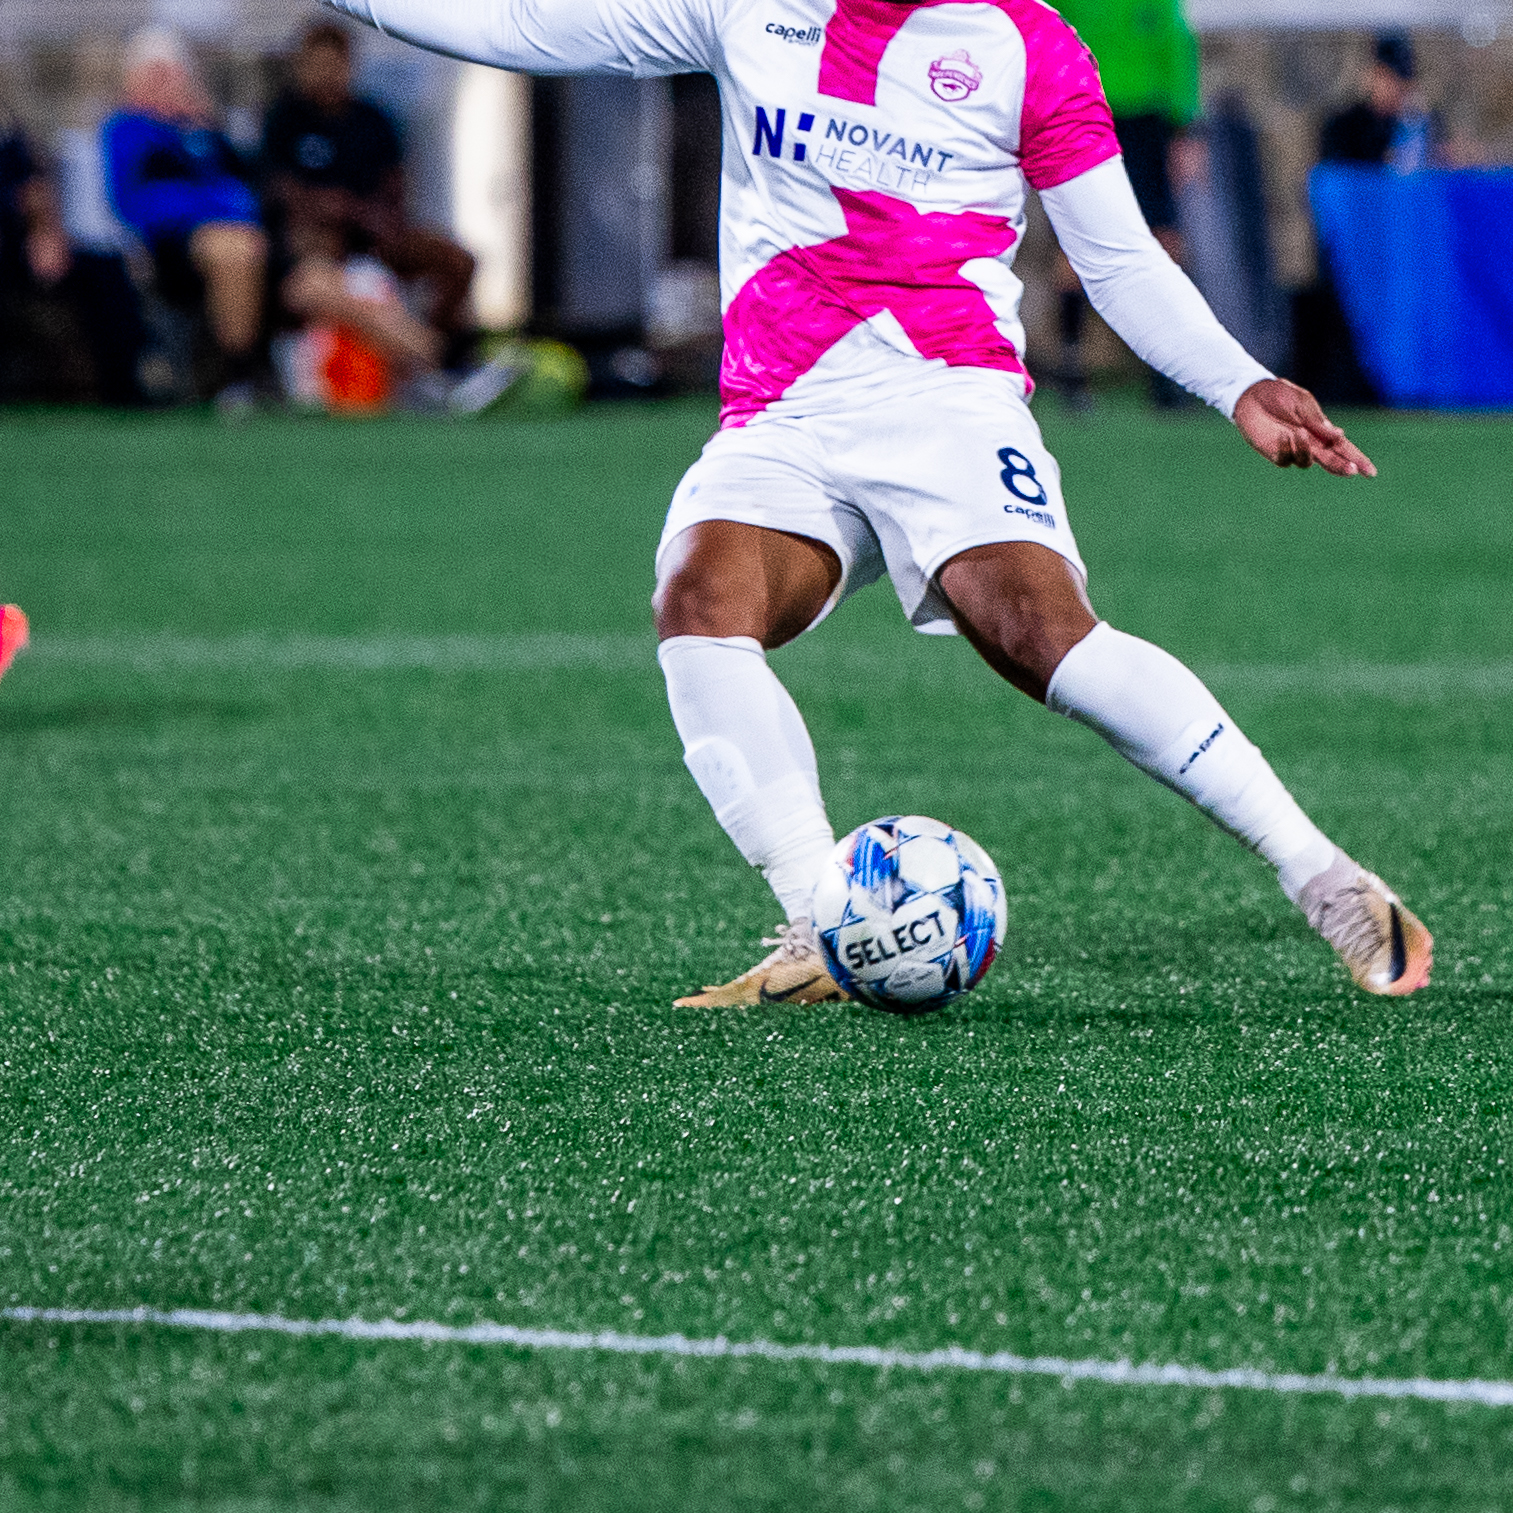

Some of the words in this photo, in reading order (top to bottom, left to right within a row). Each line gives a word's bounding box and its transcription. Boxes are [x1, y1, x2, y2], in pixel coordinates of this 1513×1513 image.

[765, 23, 822, 43] capelli
[815, 144, 933, 194] HEALTH
[825, 118, 954, 172] NOVANT
[996, 446, 1048, 506] 8
[844, 910, 946, 970] SELECT
